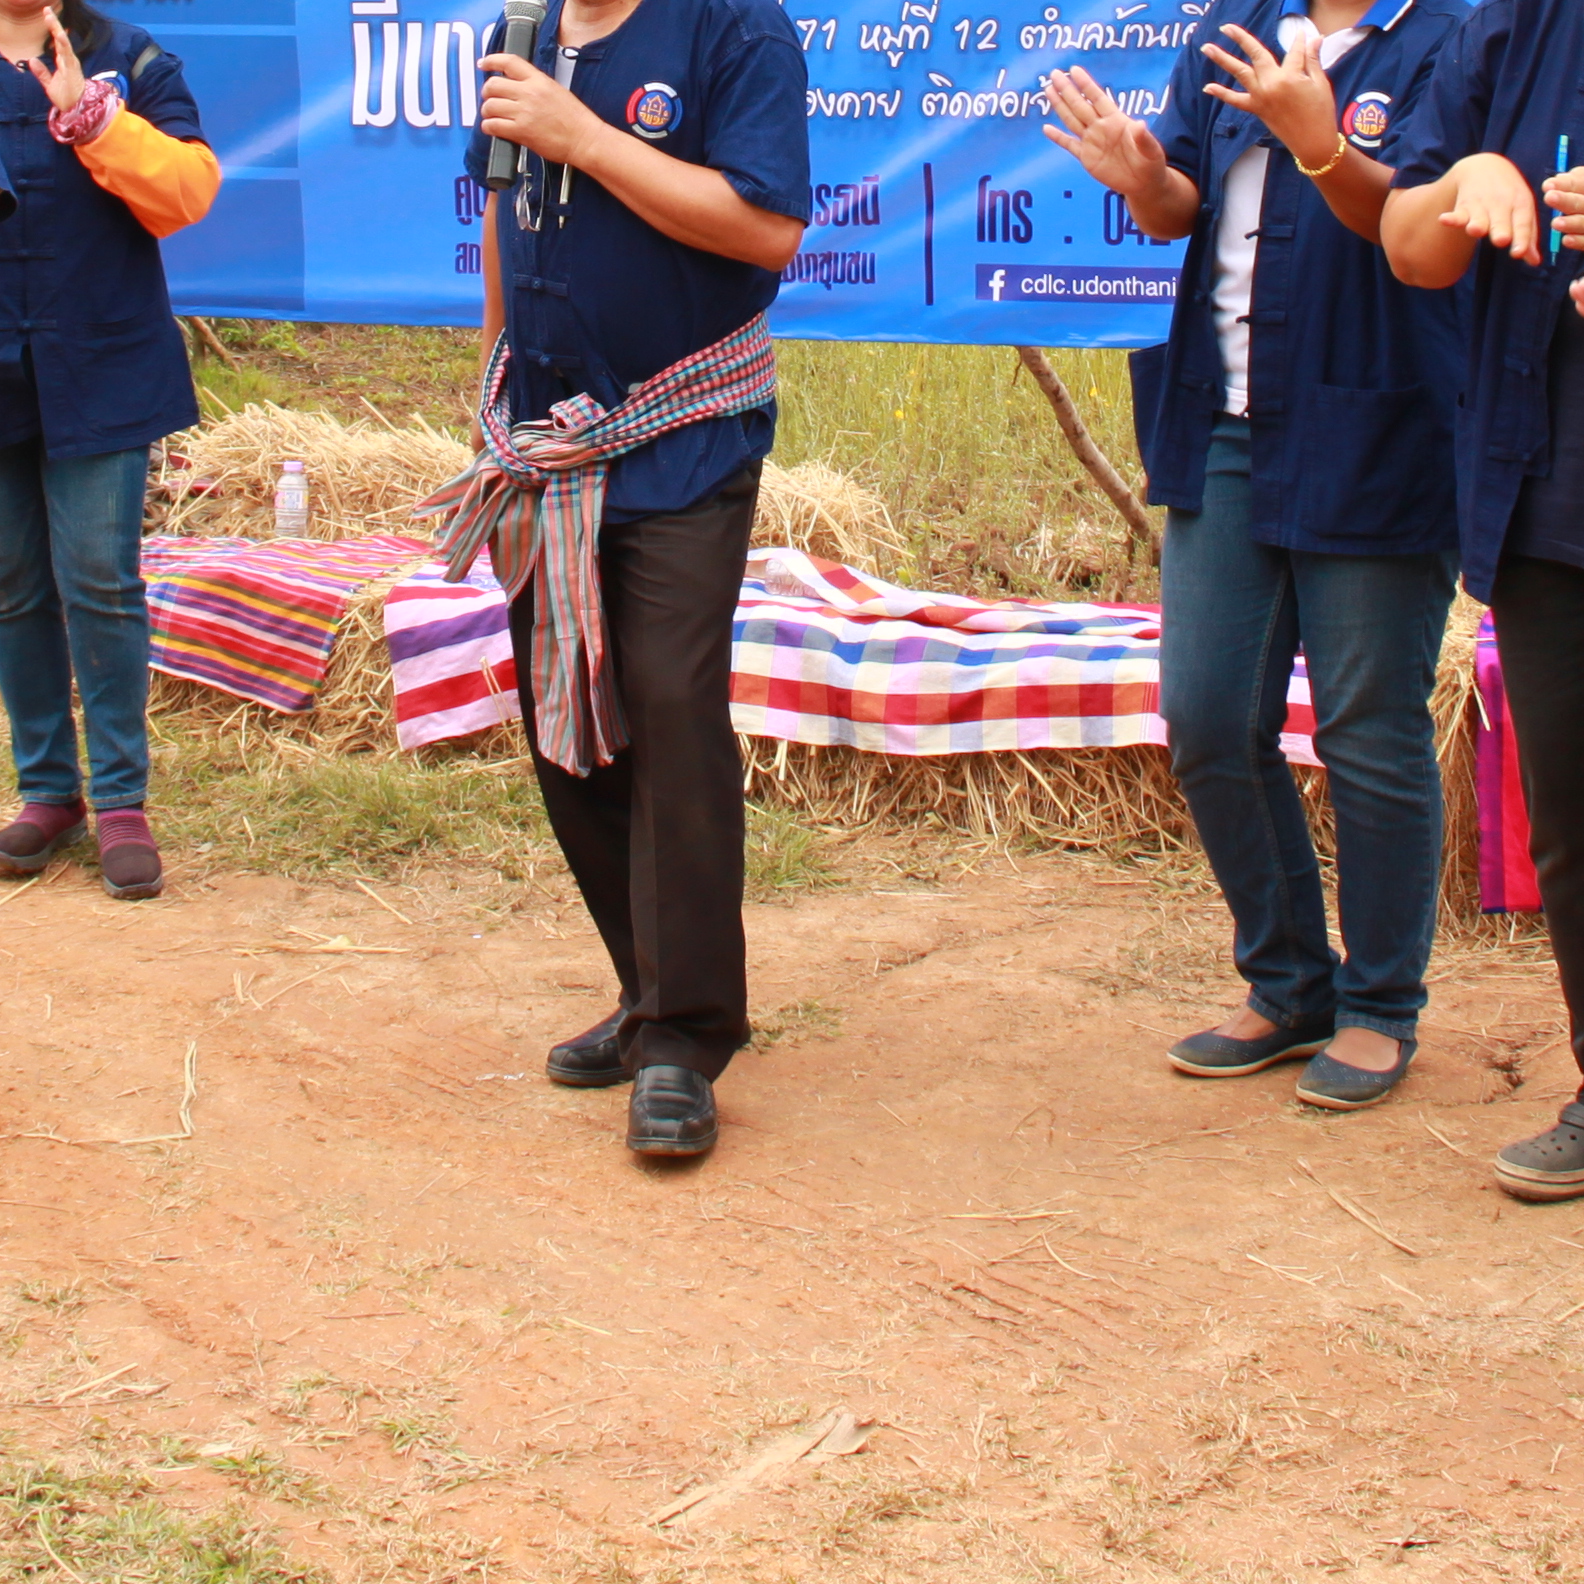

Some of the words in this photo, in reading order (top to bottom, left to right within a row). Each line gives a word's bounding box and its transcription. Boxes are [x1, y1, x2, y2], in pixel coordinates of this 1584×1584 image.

[954, 18, 1000, 52] 12
[805, 87, 902, 119] องคาย
[976, 174, 1034, 244] โทร
